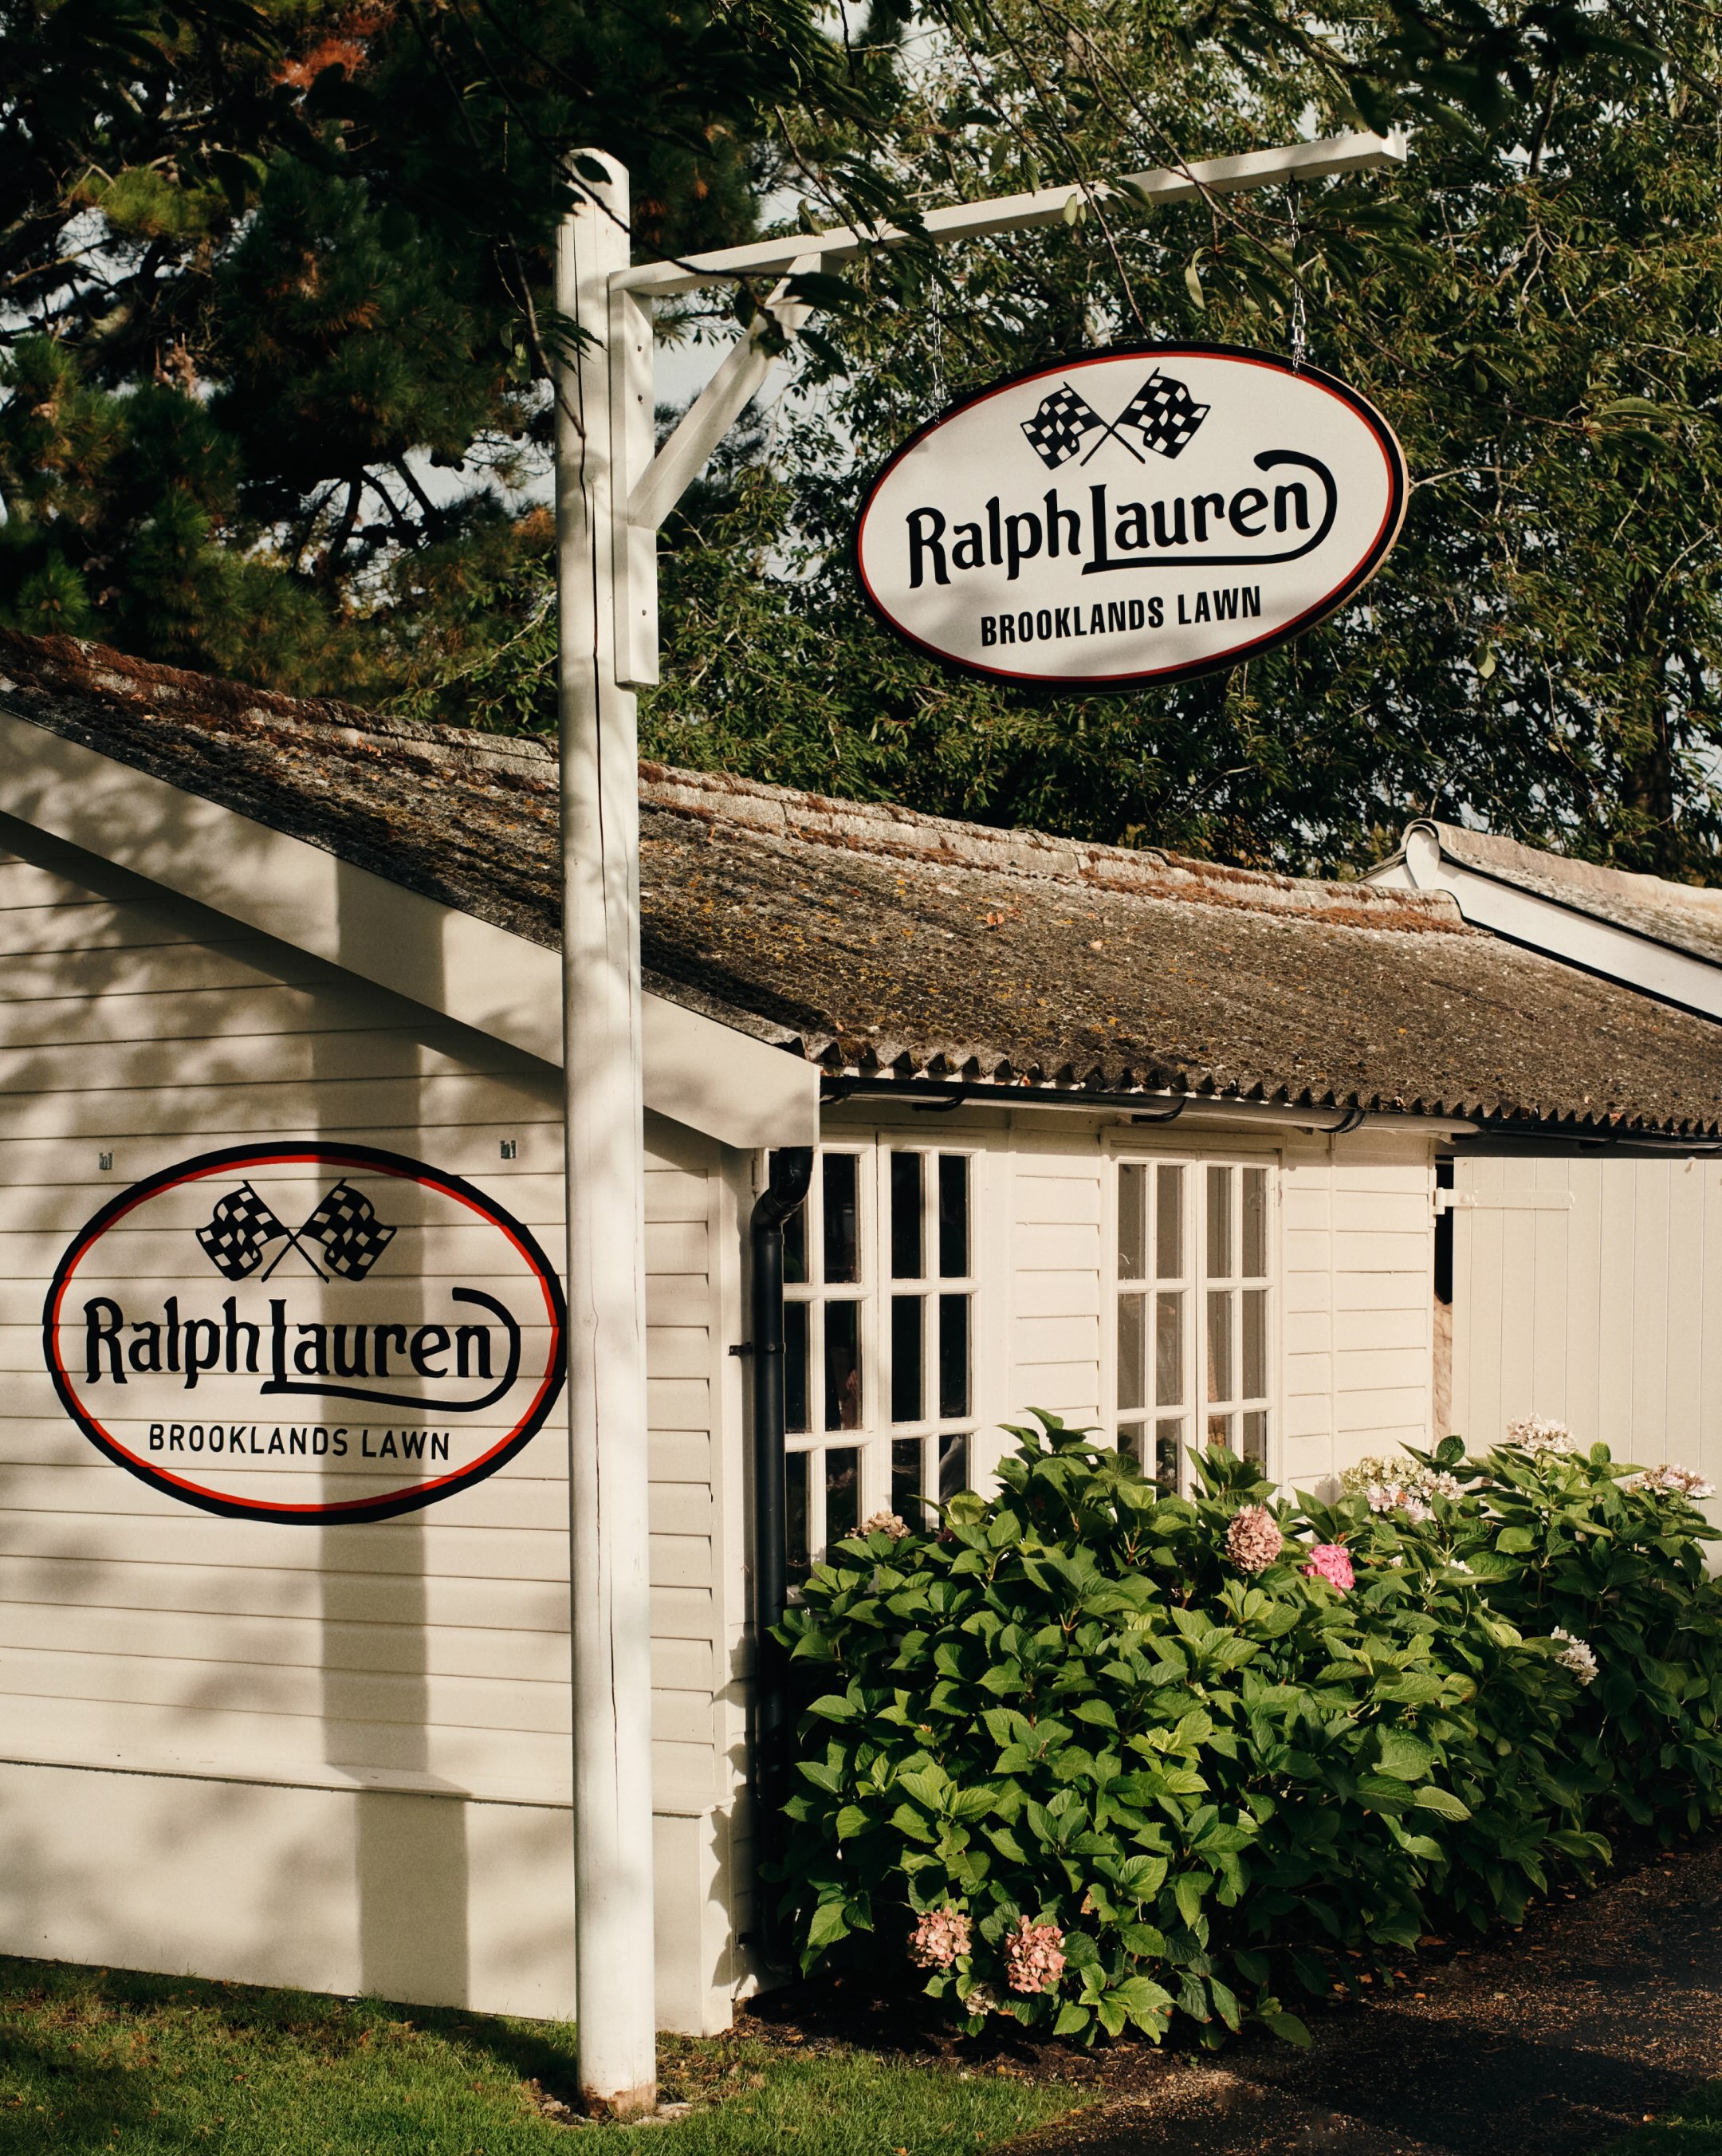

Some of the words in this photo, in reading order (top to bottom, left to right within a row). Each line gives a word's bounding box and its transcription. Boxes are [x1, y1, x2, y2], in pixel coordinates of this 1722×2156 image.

[905, 488, 1081, 589] Ralph
[1081, 449, 1338, 576] Lauren
[981, 596, 1164, 647] BROOKLANDS
[1177, 585, 1261, 625] LAWN
[82, 1296, 261, 1390] Ralph
[260, 1286, 523, 1413] Lauren
[149, 1423, 348, 1457] BROOKLANDS
[361, 1429, 450, 1461] LAWN
